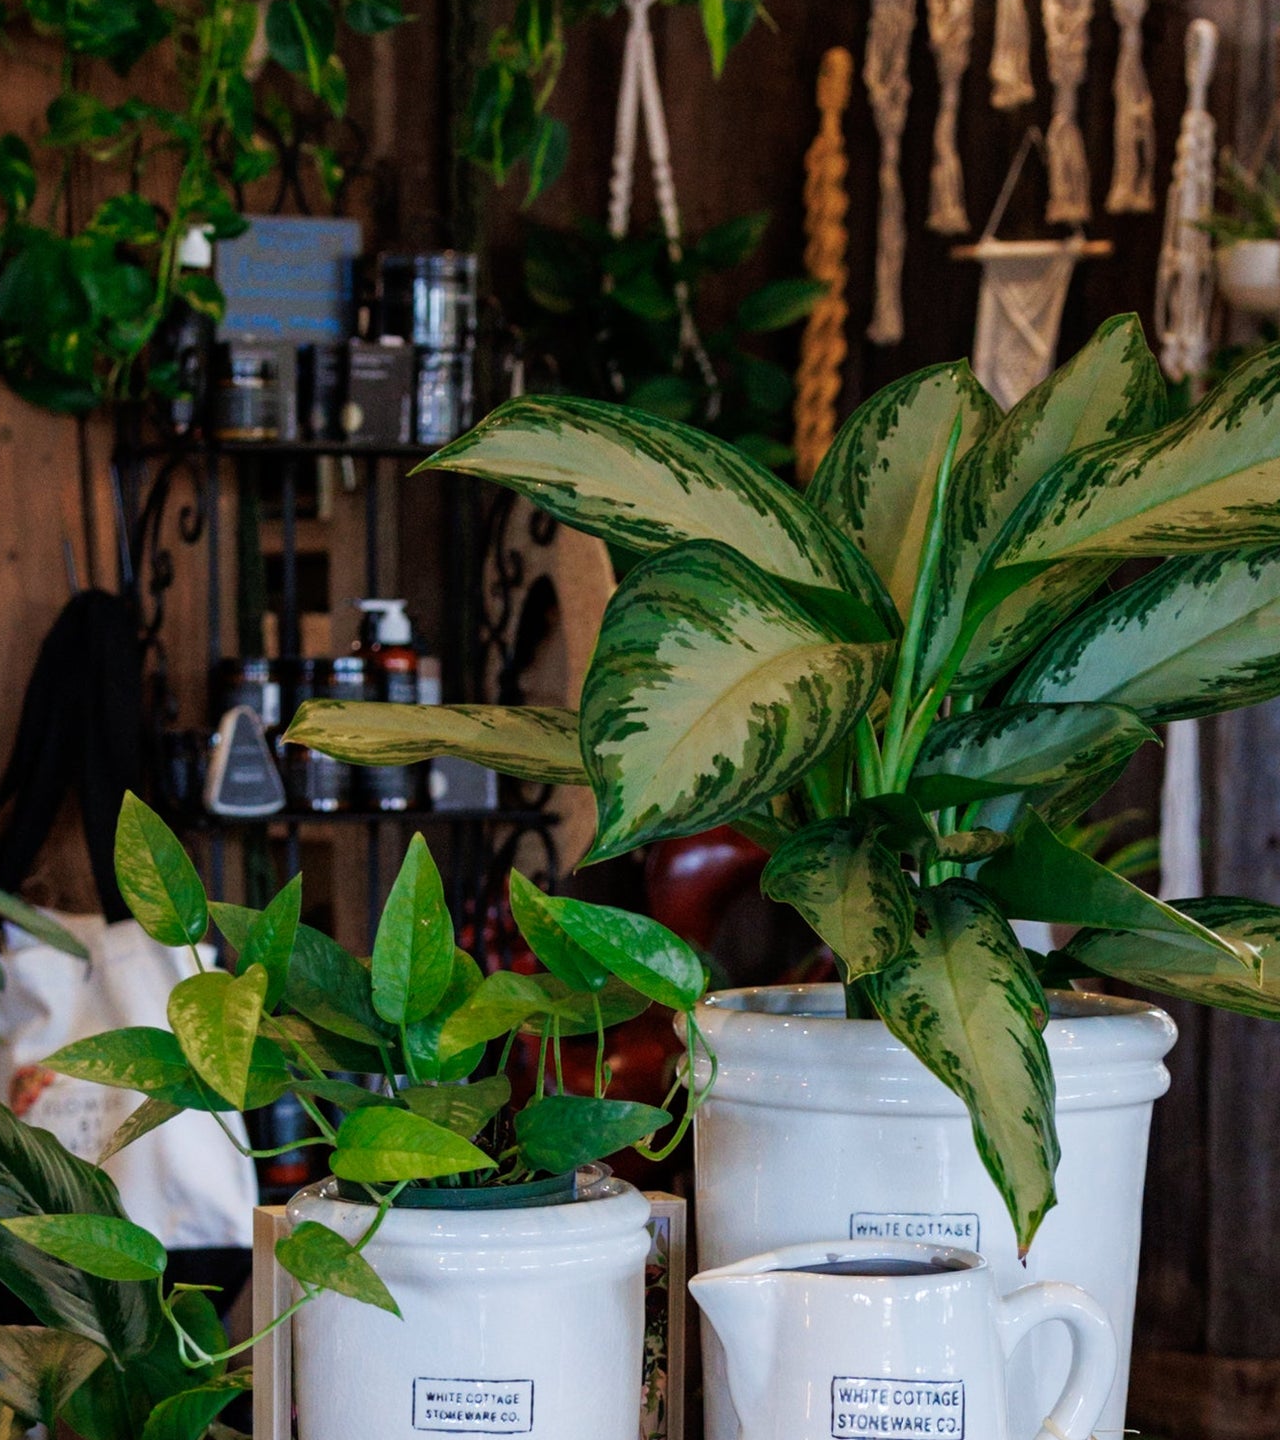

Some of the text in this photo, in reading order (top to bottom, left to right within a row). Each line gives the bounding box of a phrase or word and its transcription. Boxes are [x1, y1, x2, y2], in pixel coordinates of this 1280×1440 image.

[857, 1222, 972, 1237] WHITE COTTAGE
[426, 1391, 520, 1406] WHITE COTTAGE
[839, 1387, 960, 1407] WHITE COTTAGE
[426, 1408, 520, 1423] STONEWARE CO.
[837, 1413, 961, 1433] STONEWARE CO.
